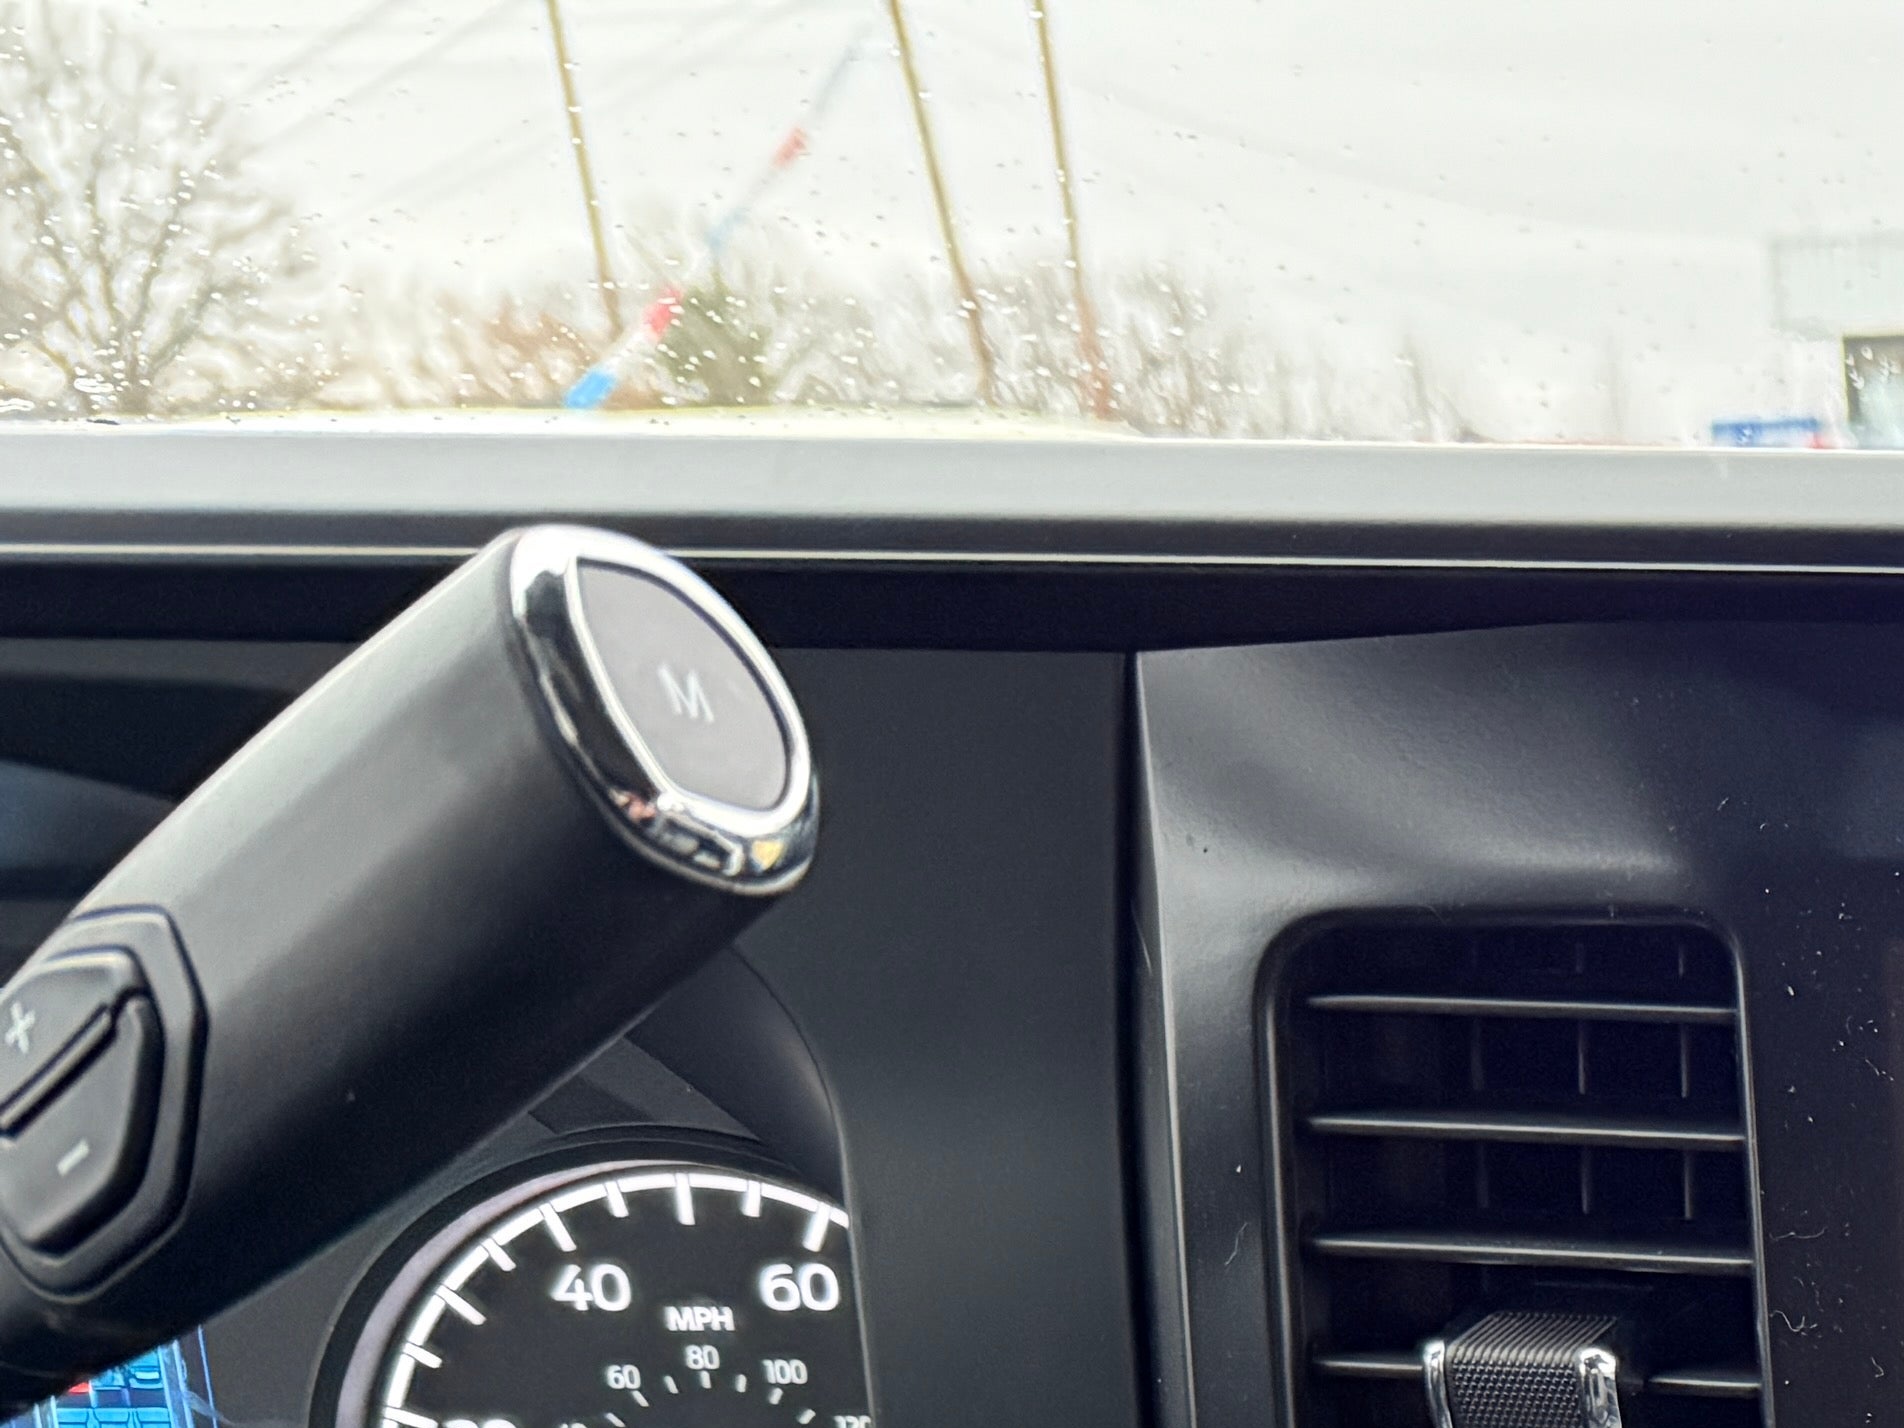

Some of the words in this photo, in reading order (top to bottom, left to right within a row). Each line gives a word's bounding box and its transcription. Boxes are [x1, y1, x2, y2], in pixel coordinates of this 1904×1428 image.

[658, 664, 715, 723] M
[550, 1263, 632, 1312] 40
[758, 1262, 840, 1312] 60
[664, 1305, 735, 1332] MPH
[685, 1344, 720, 1370] 80
[606, 1364, 641, 1389] 60
[762, 1359, 808, 1385] 100
